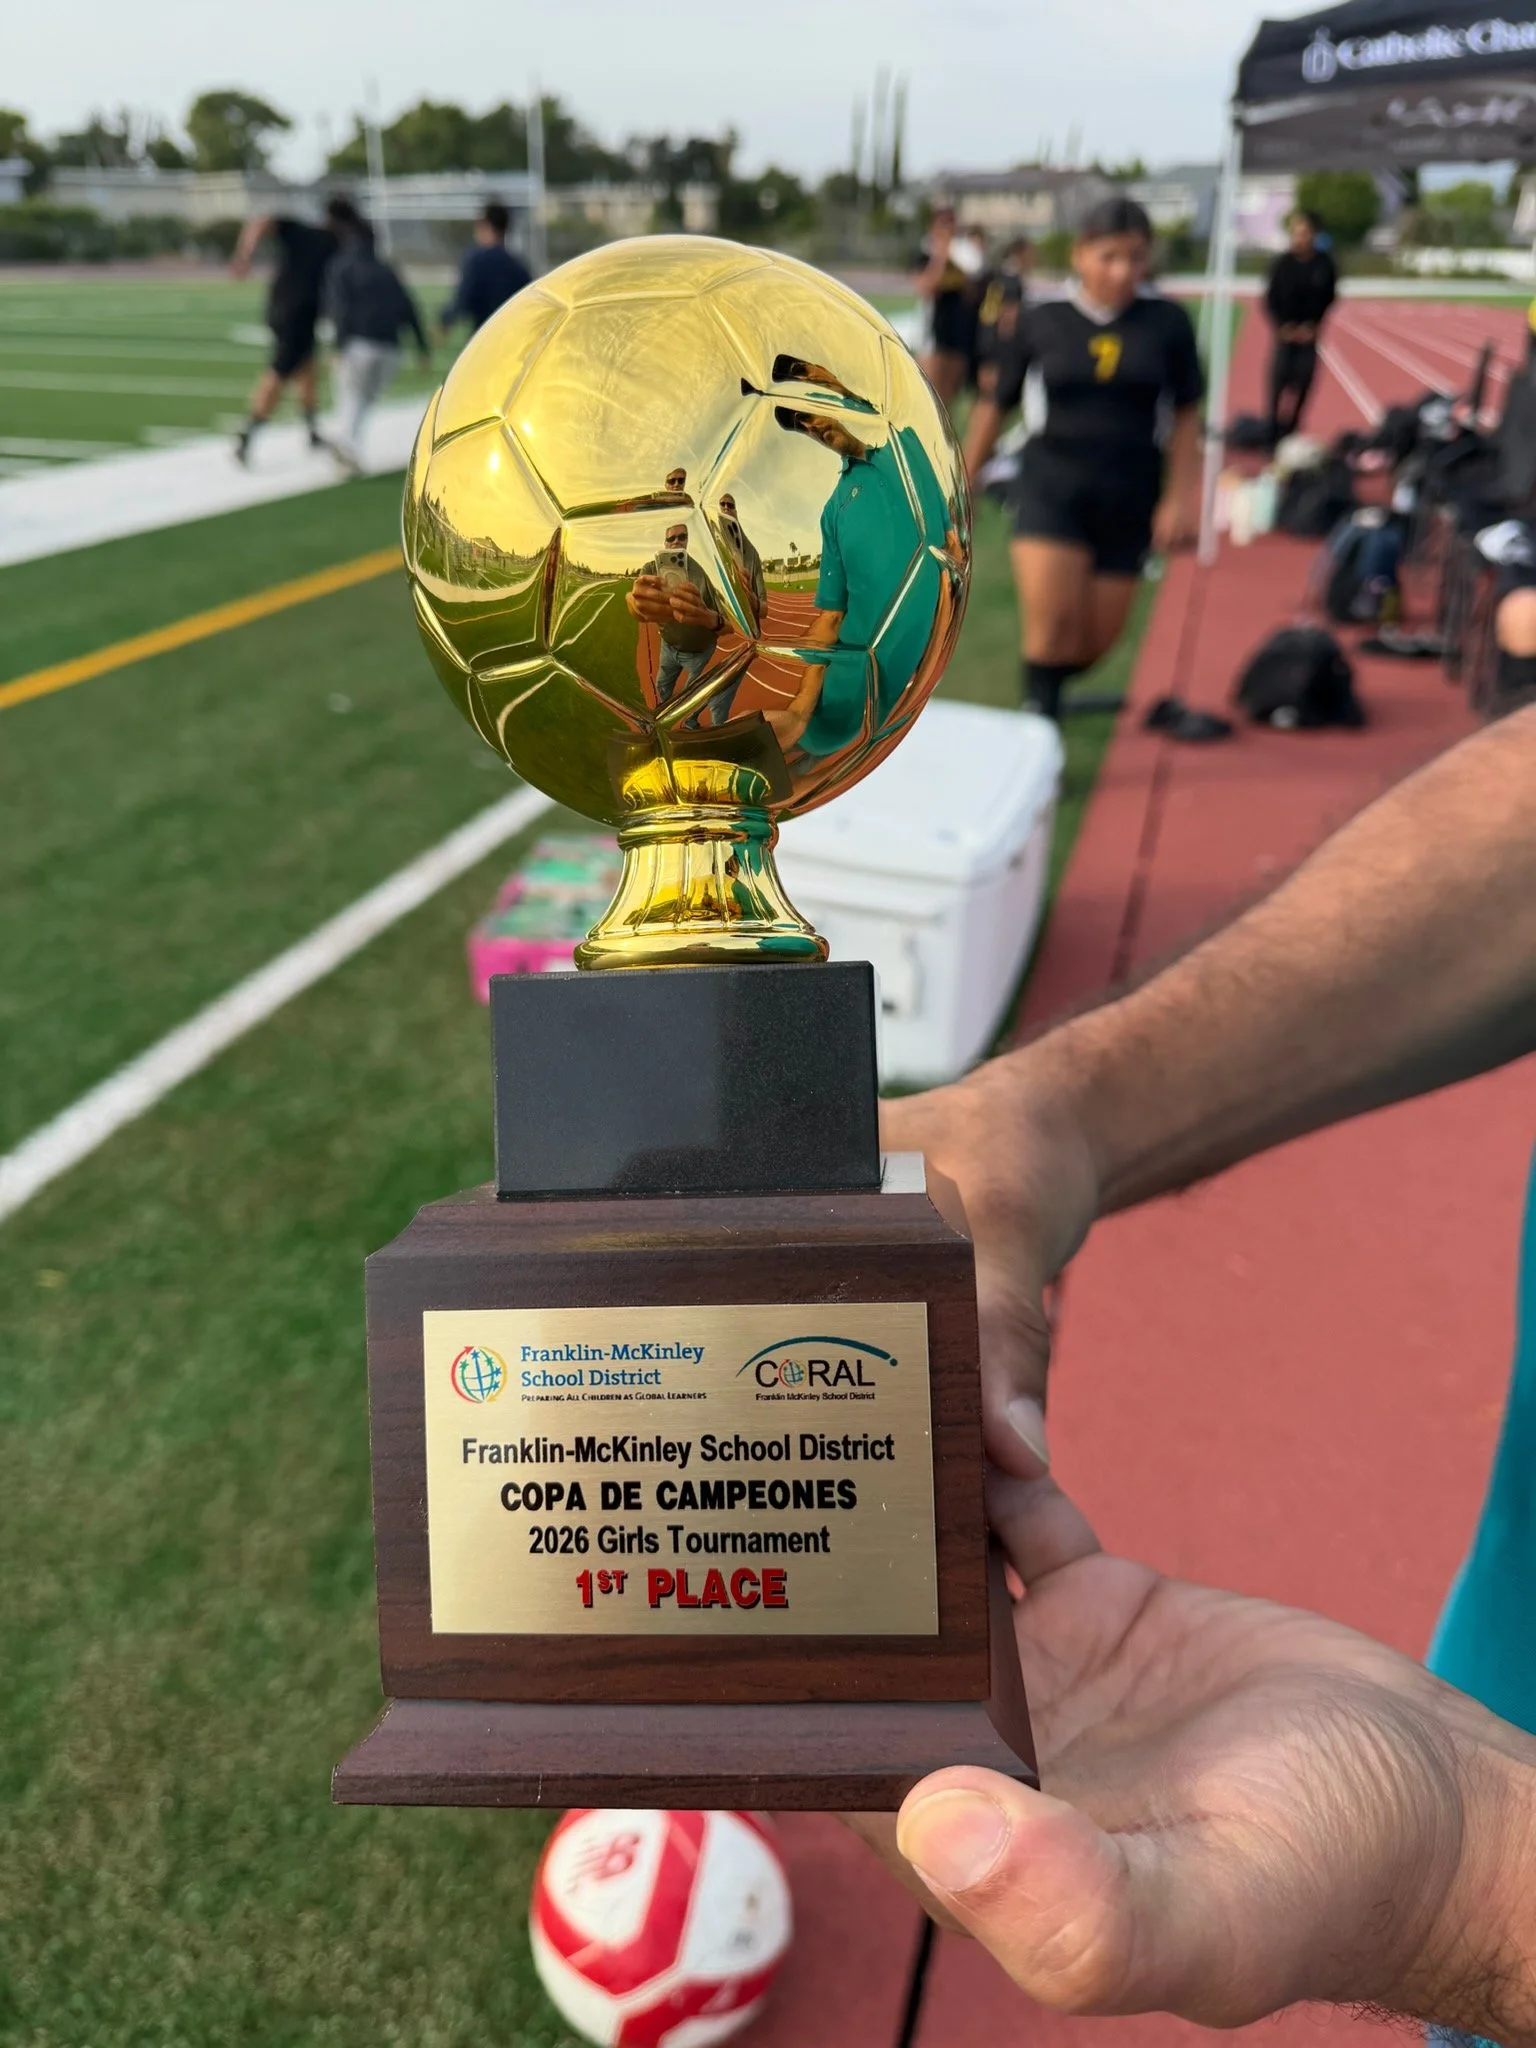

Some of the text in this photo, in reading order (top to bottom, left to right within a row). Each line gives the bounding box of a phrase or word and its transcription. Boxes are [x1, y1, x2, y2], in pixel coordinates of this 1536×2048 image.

[1088, 333, 1124, 383] 7
[521, 1342, 705, 1364] Franklin-McKinley
[521, 1368, 662, 1387] School District
[755, 1359, 876, 1388] CORAL
[522, 1393, 565, 1401] PREPARING
[566, 1393, 580, 1401] ALL
[582, 1392, 622, 1401] CHILDREN
[635, 1392, 665, 1401] GLOBAL
[667, 1392, 707, 1400] LEARNERS
[755, 1391, 876, 1402] Franklin McKinley School District
[462, 1433, 896, 1470] Franklin-McKinley School District
[500, 1479, 858, 1511] COPA DE CAMPEONES
[528, 1524, 831, 1554] 2026 Girls Tournament
[575, 1567, 790, 1609] 1ST PLACE
